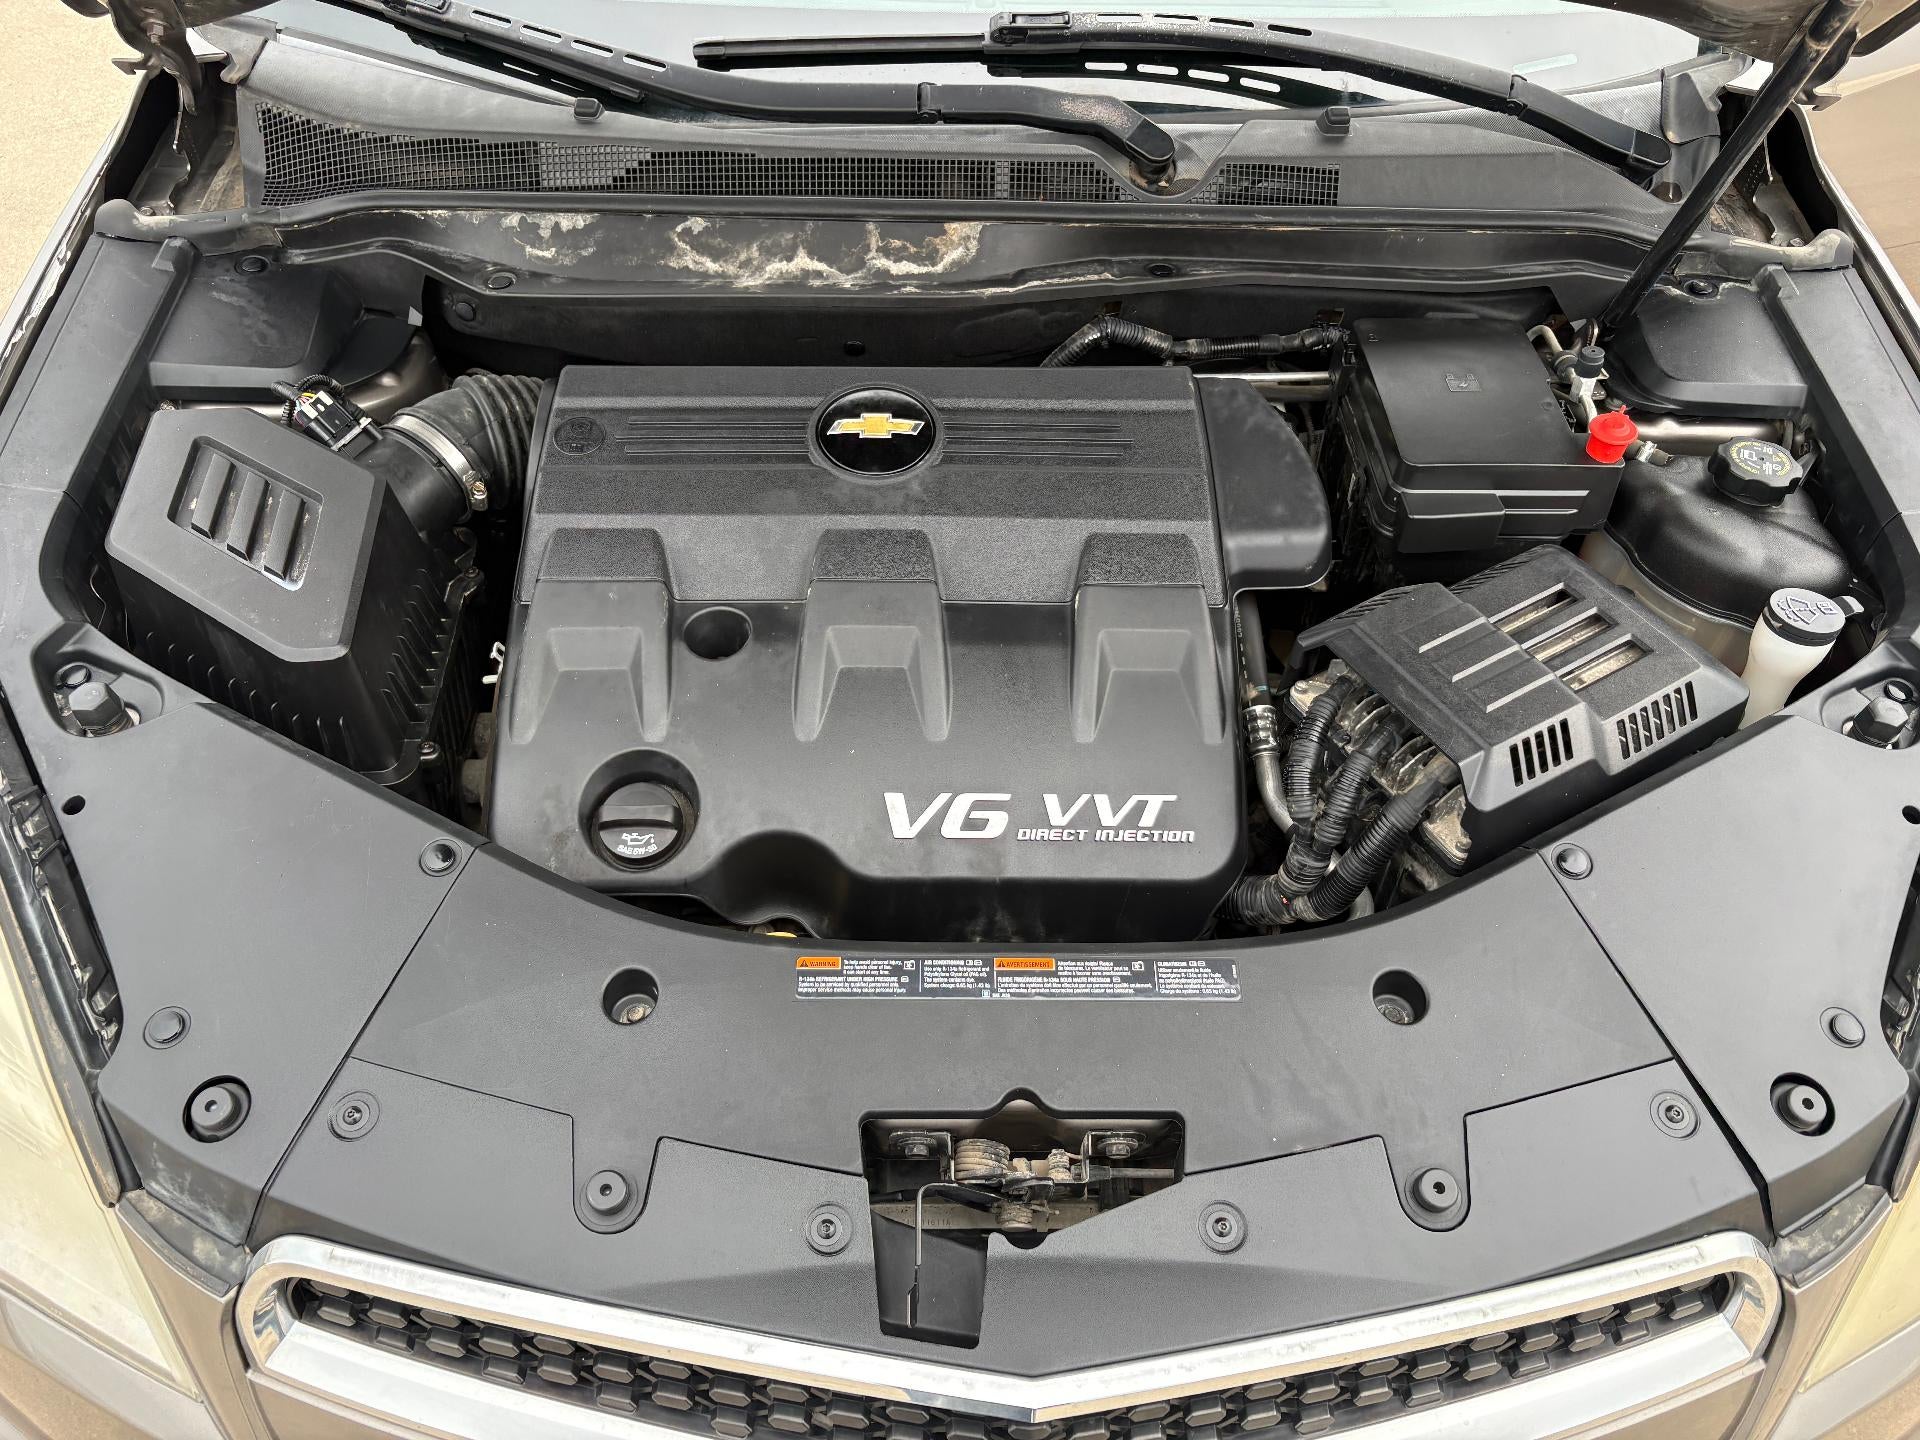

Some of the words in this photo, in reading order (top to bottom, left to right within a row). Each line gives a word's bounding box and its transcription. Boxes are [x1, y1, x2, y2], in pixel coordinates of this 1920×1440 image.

[884, 792, 1012, 839] V6
[1043, 793, 1178, 828] VVT
[1016, 829, 1089, 842] DIRECT
[1095, 829, 1196, 842] INJECTION
[617, 844, 633, 854] SAE
